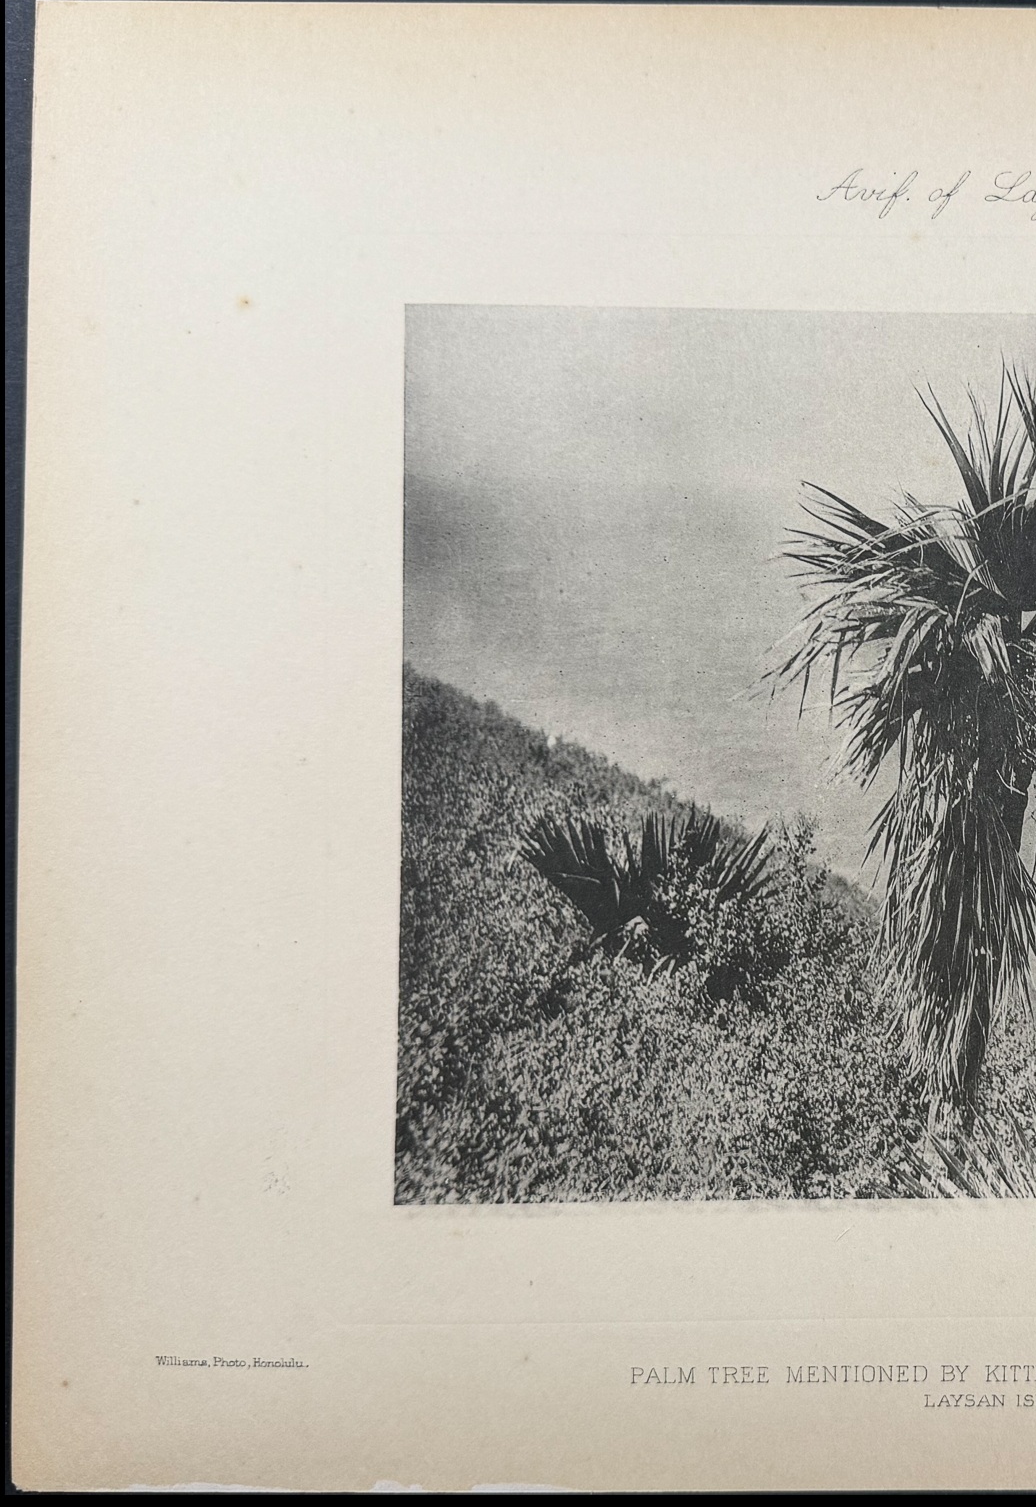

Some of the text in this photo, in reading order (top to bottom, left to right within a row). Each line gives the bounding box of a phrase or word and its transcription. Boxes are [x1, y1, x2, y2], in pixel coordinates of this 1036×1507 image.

[816, 168, 919, 220] Avif.
[928, 170, 972, 220] of
[253, 1358, 310, 1369] Honolulu.
[630, 1367, 697, 1384] PALM
[708, 1366, 770, 1384] TREE
[786, 1365, 929, 1383] MENTIONED
[940, 1365, 970, 1383] BY
[924, 1394, 1006, 1408] LAYSAN
